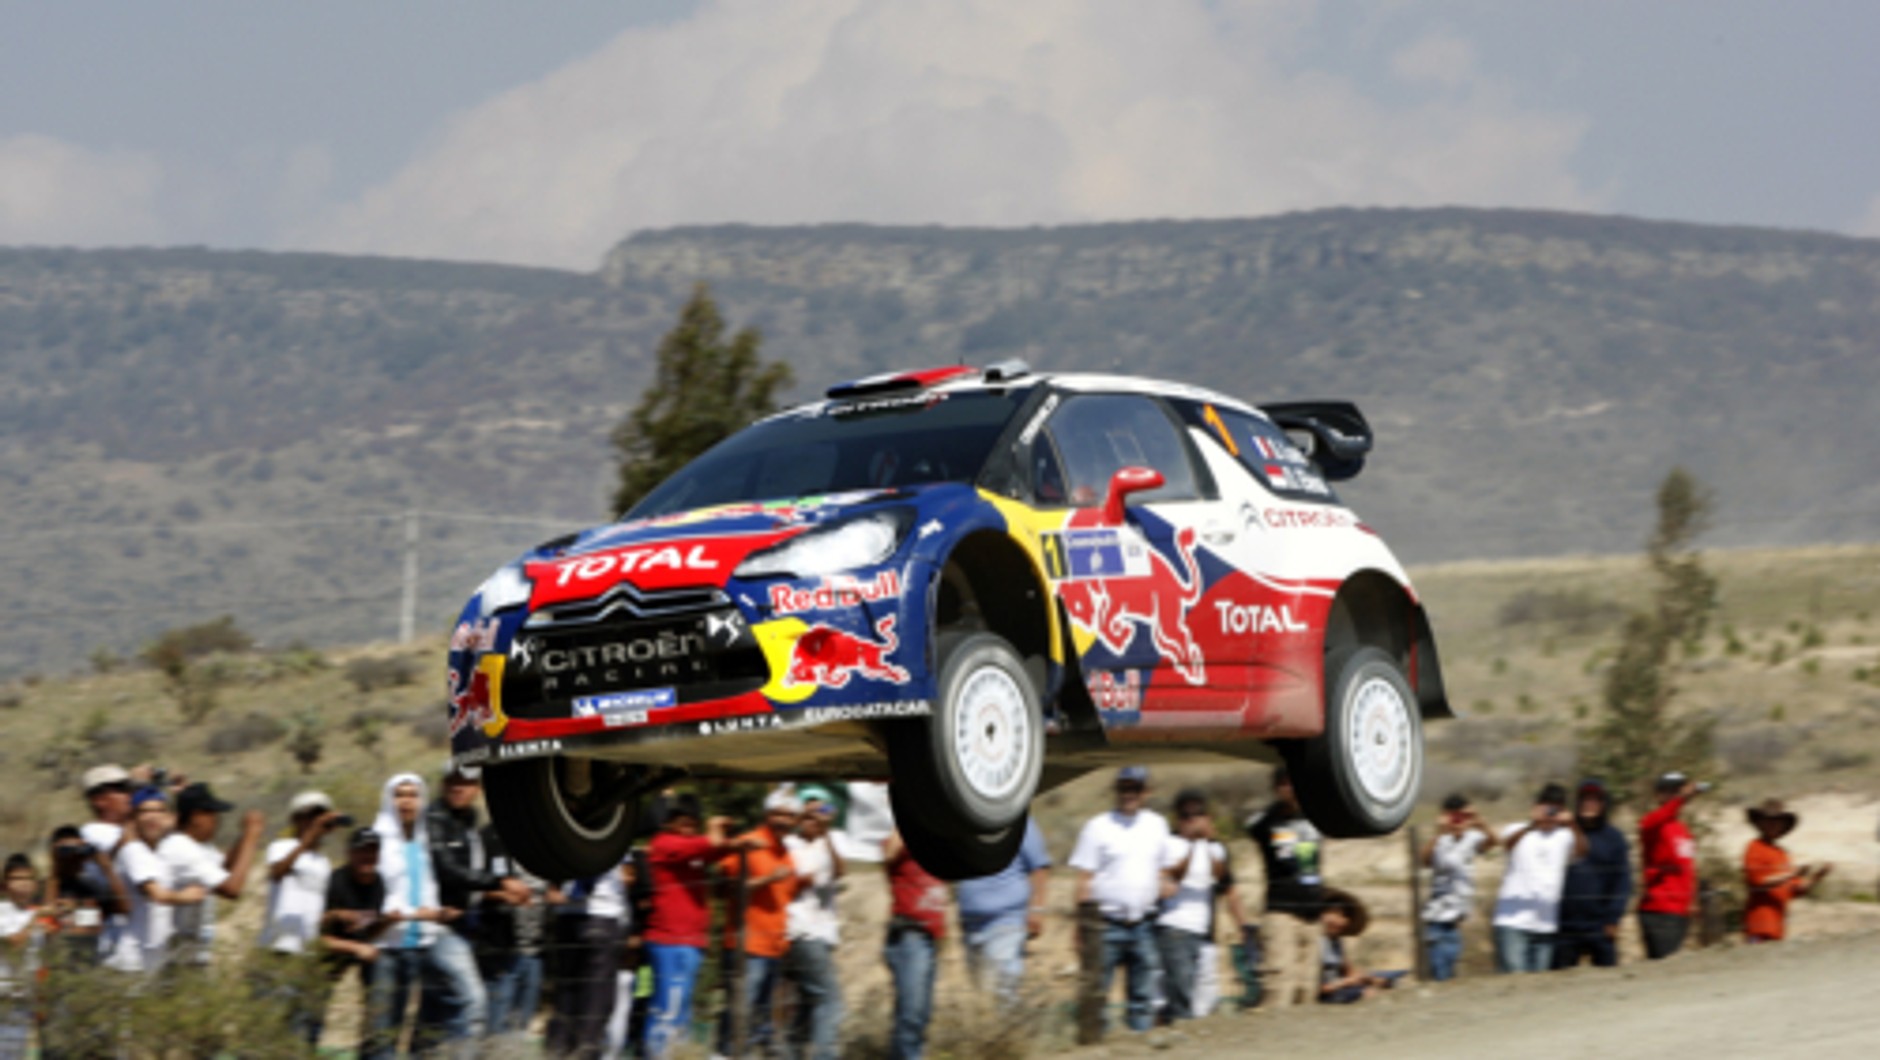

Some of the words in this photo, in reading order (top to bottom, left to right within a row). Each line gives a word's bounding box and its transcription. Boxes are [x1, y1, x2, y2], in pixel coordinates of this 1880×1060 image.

[1203, 402, 1239, 457] 1
[556, 545, 719, 586] TOTAL
[1045, 534, 1062, 577] 1
[769, 582, 834, 613] Red
[1214, 600, 1308, 633] TOTAL
